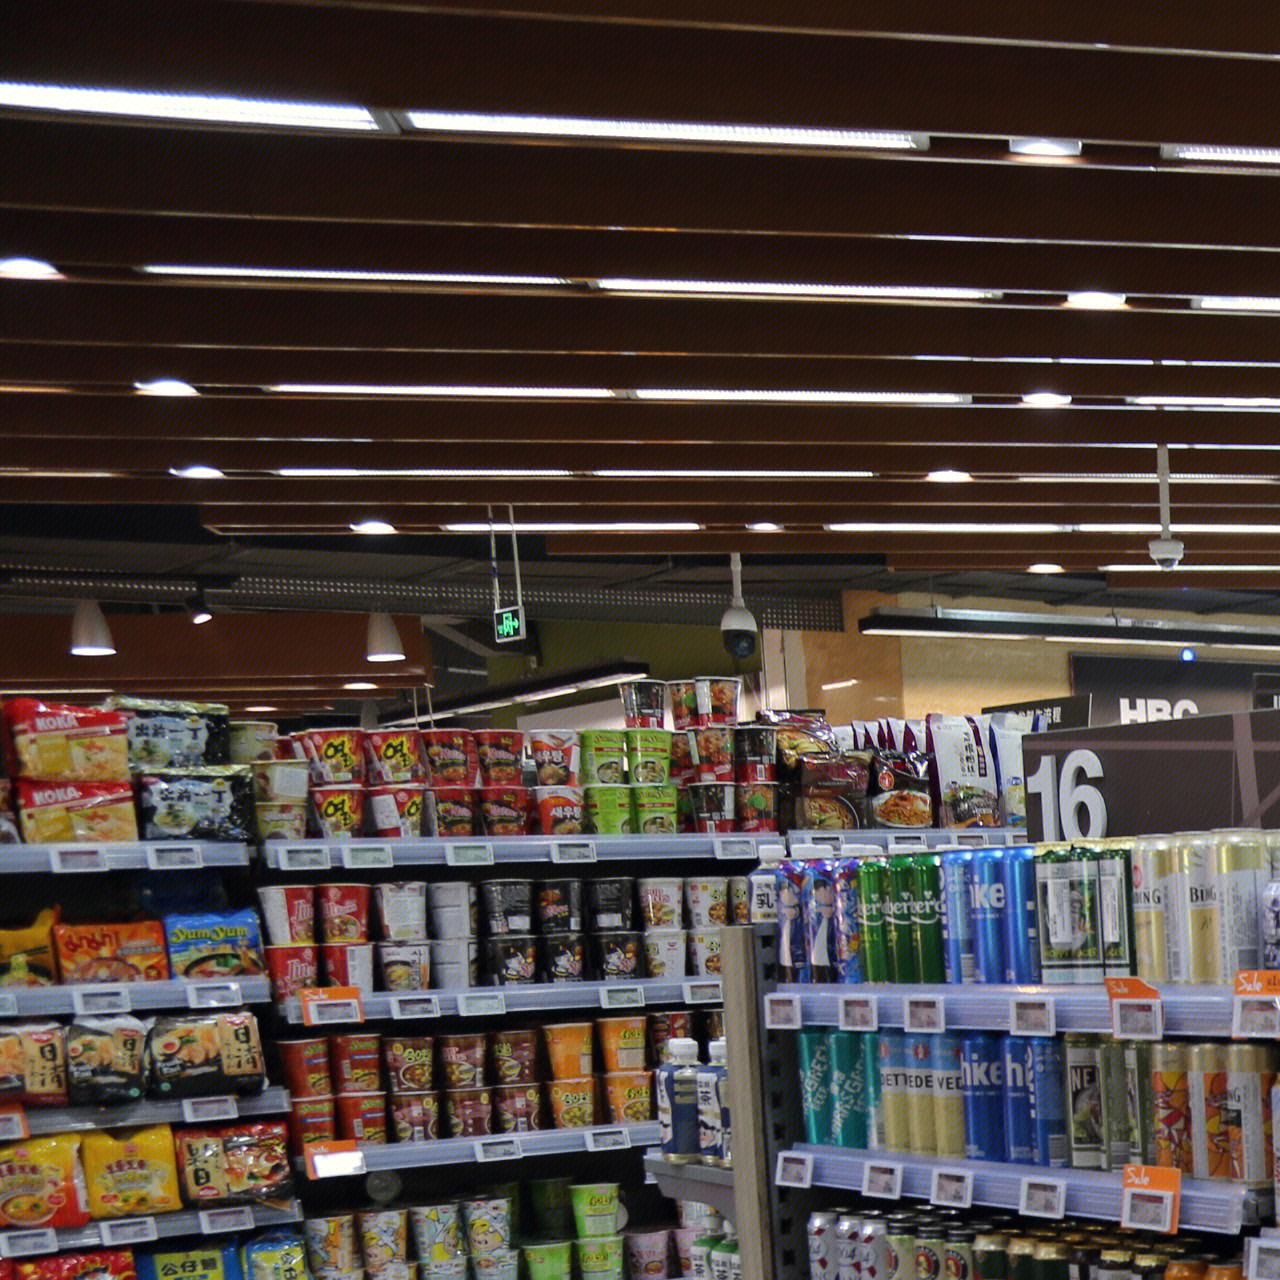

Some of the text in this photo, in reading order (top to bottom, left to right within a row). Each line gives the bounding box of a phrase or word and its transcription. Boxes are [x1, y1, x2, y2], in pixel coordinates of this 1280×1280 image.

[36, 714, 79, 732] KOKA
[33, 786, 78, 803] KOKA
[1026, 749, 1108, 843] 16
[1239, 974, 1264, 992] Sale
[1126, 1166, 1150, 1186] Sale
